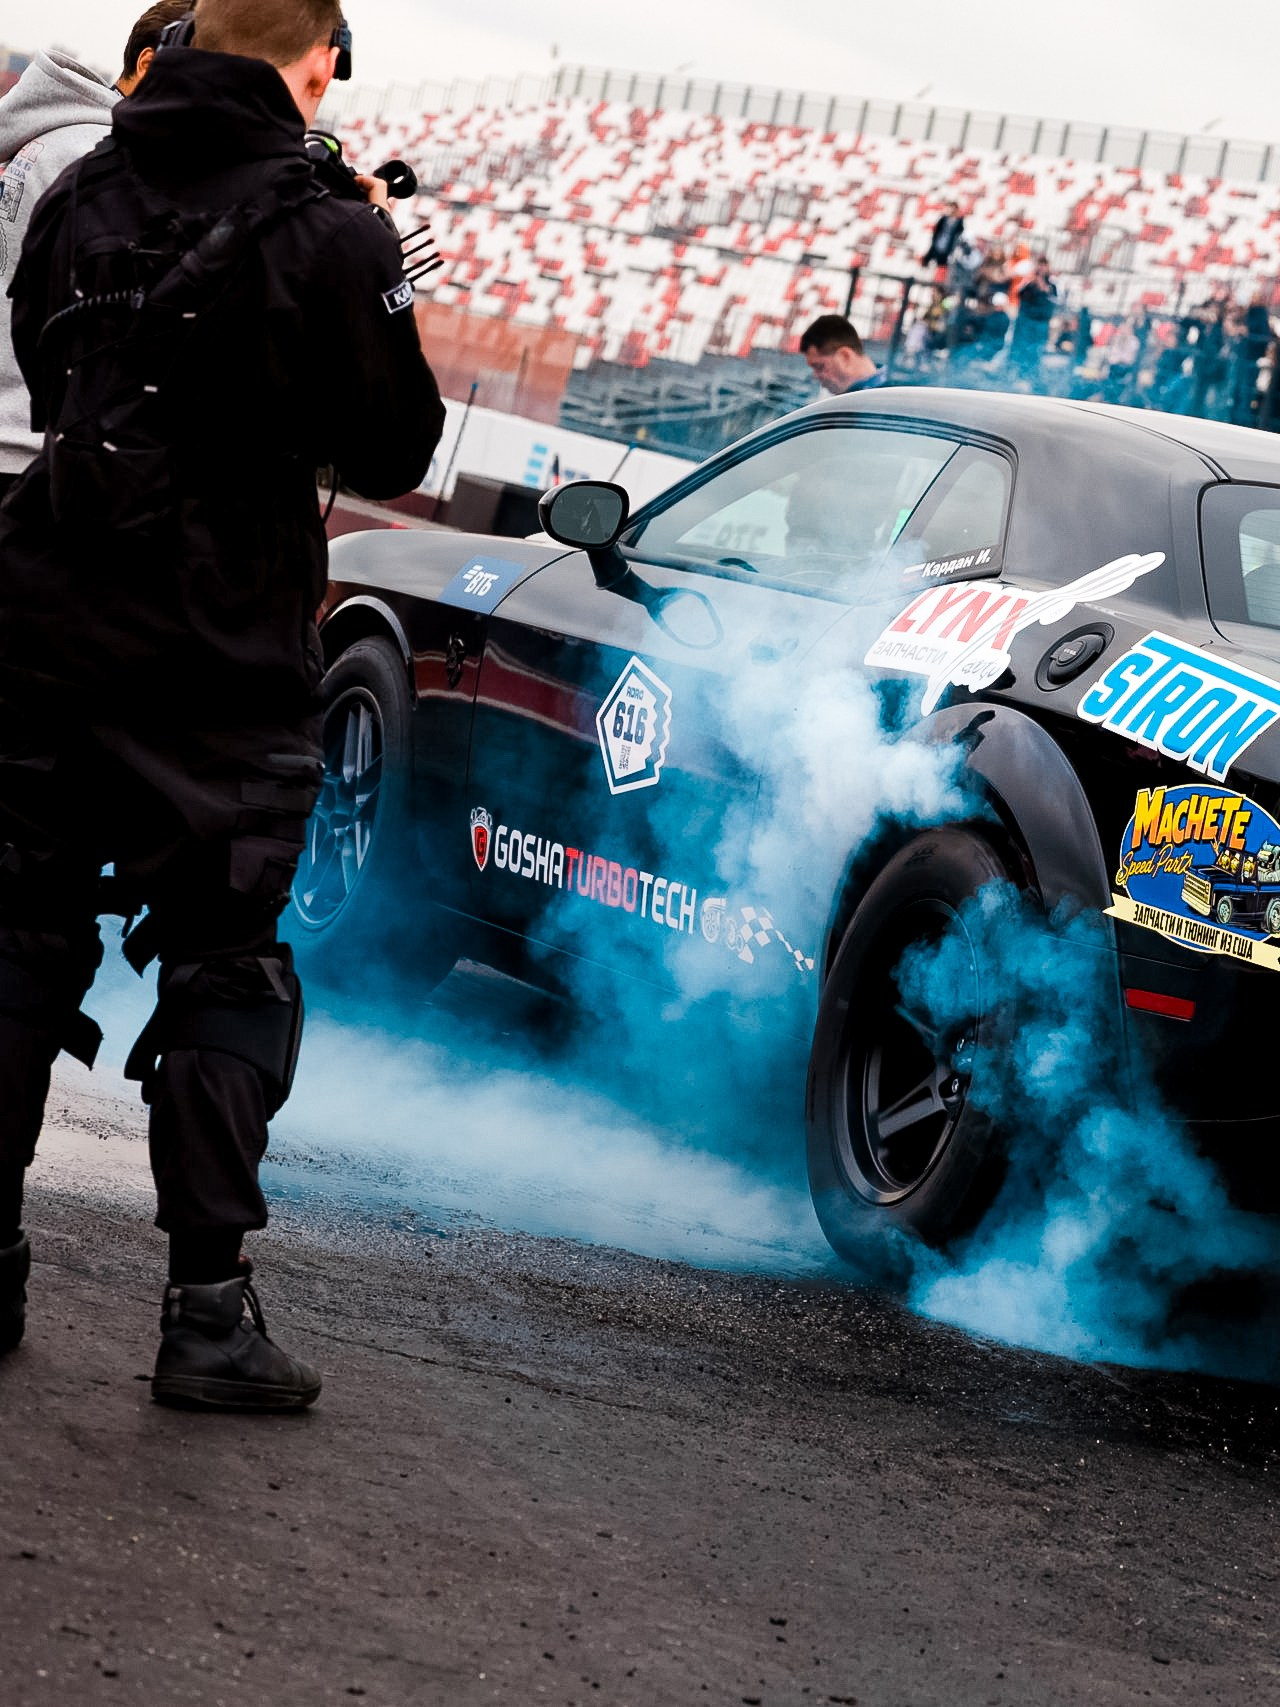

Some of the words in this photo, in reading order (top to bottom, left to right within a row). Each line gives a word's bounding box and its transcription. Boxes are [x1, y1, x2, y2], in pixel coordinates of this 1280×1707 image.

[921, 555, 975, 578] Кардан
[975, 549, 991, 564] И.
[872, 641, 949, 665] ЗАПЧАСТИ
[612, 701, 648, 746] 616
[494, 825, 697, 934] GOSHATURBOTECH
[1116, 851, 1156, 884] Speed
[1152, 844, 1194, 878] Parts
[1133, 904, 1176, 933] ЗАПЧАСТИ
[1175, 921, 1183, 936] И
[1184, 919, 1219, 946] ТЮНИНГ
[1220, 932, 1232, 951] ИЗ
[1233, 937, 1253, 959] США
